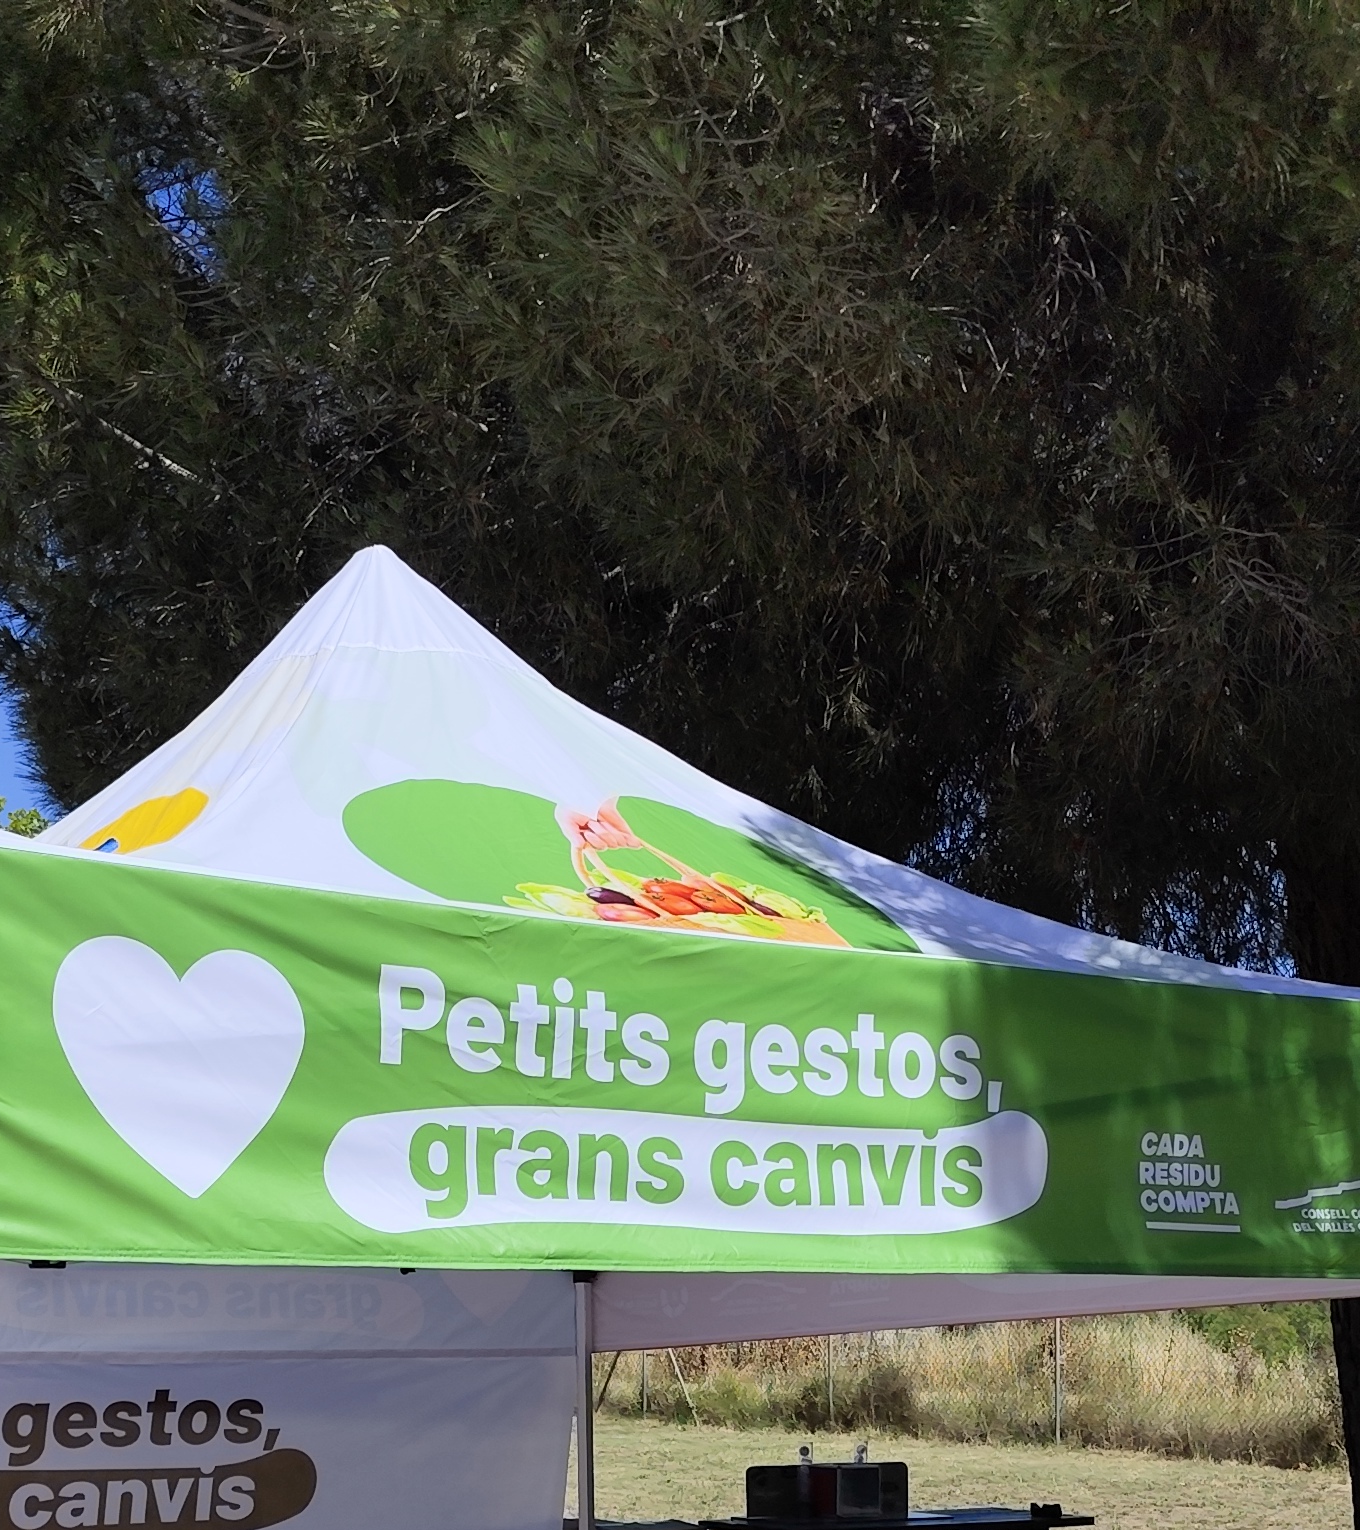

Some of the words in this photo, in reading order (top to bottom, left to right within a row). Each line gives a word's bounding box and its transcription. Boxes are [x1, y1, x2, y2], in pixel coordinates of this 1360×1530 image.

[377, 963, 670, 1087] Petits
[693, 1013, 1003, 1115] gestos,
[1141, 1131, 1205, 1158] CADA
[408, 1122, 685, 1219] grans
[709, 1126, 984, 1207] canvis
[1139, 1161, 1221, 1188] RESIDU
[1140, 1189, 1240, 1215] COMPTA
[1301, 1208, 1350, 1220] CONSELL
[1293, 1222, 1315, 1232] DEL
[1, 1389, 281, 1466] gestos,
[9, 1464, 256, 1530] canvis
